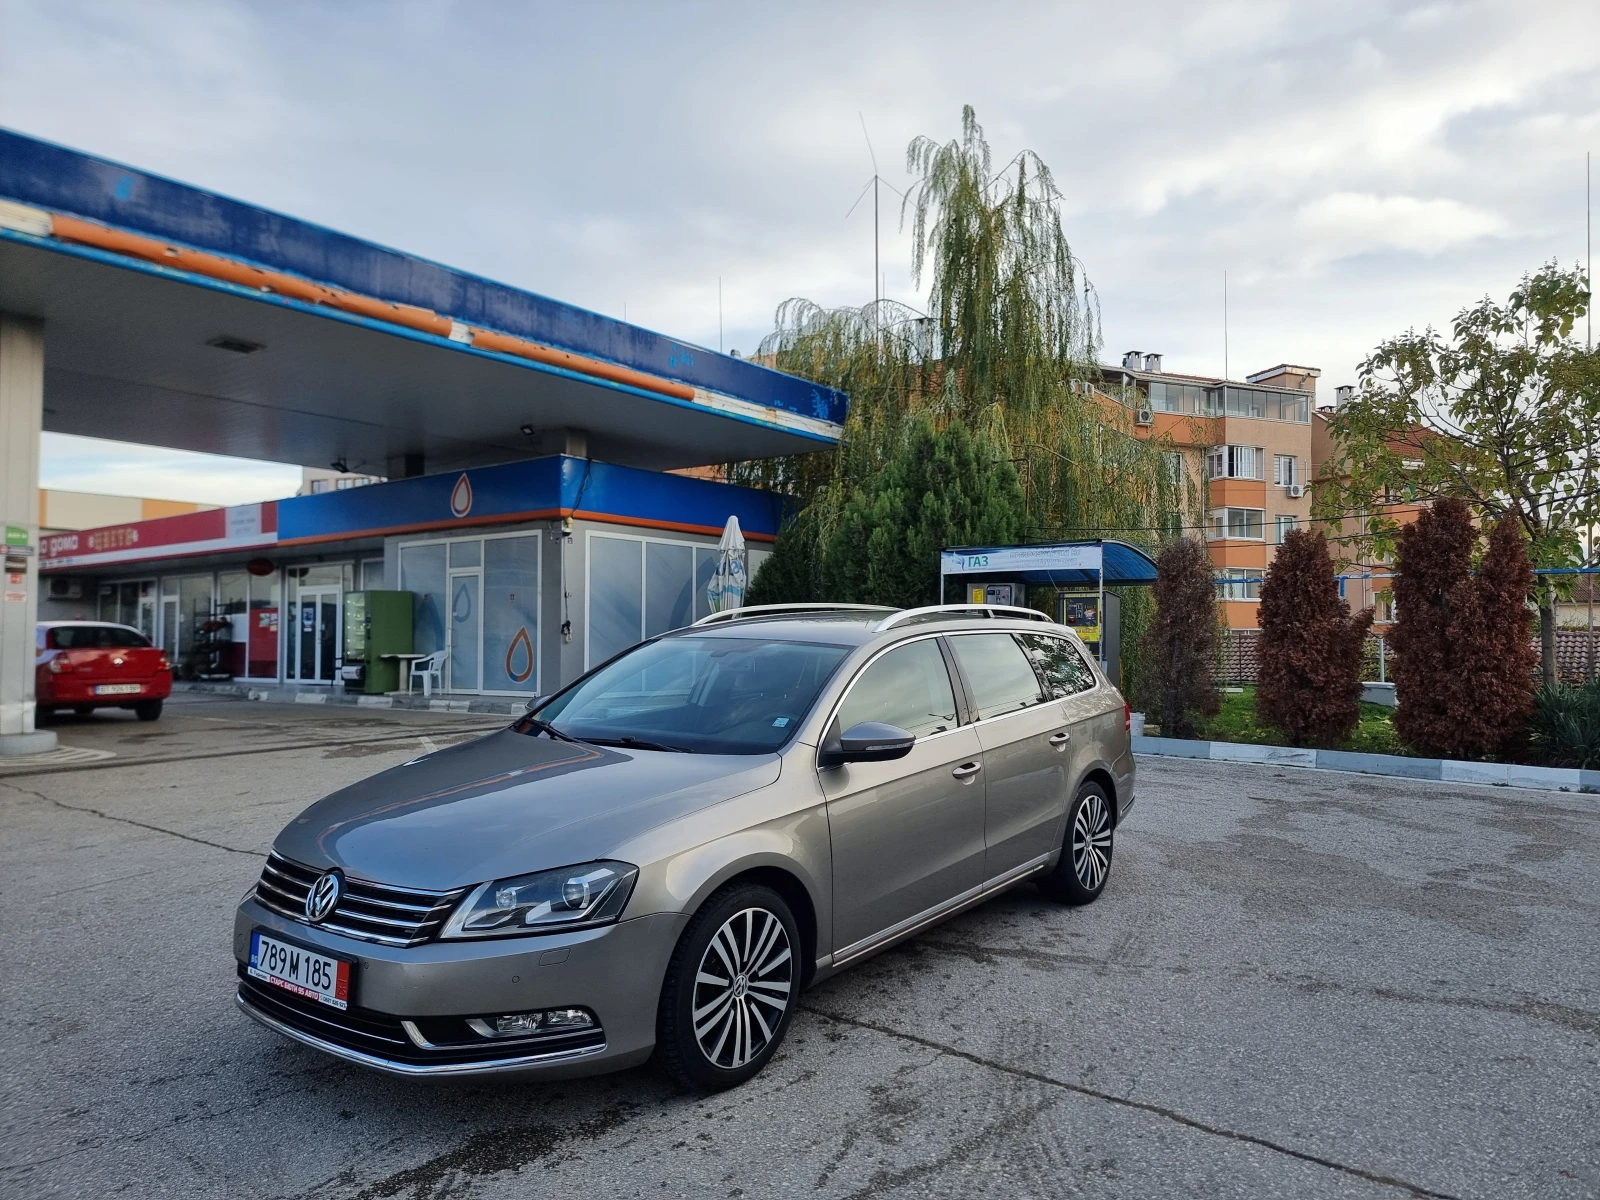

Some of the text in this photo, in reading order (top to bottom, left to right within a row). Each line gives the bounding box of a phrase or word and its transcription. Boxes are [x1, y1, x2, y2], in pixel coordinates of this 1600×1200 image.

[967, 555, 989, 568] ГАЗ
[251, 954, 258, 963] BG
[304, 955, 332, 990] 185
[298, 986, 305, 994] 95
[305, 988, 319, 999] АВТО
